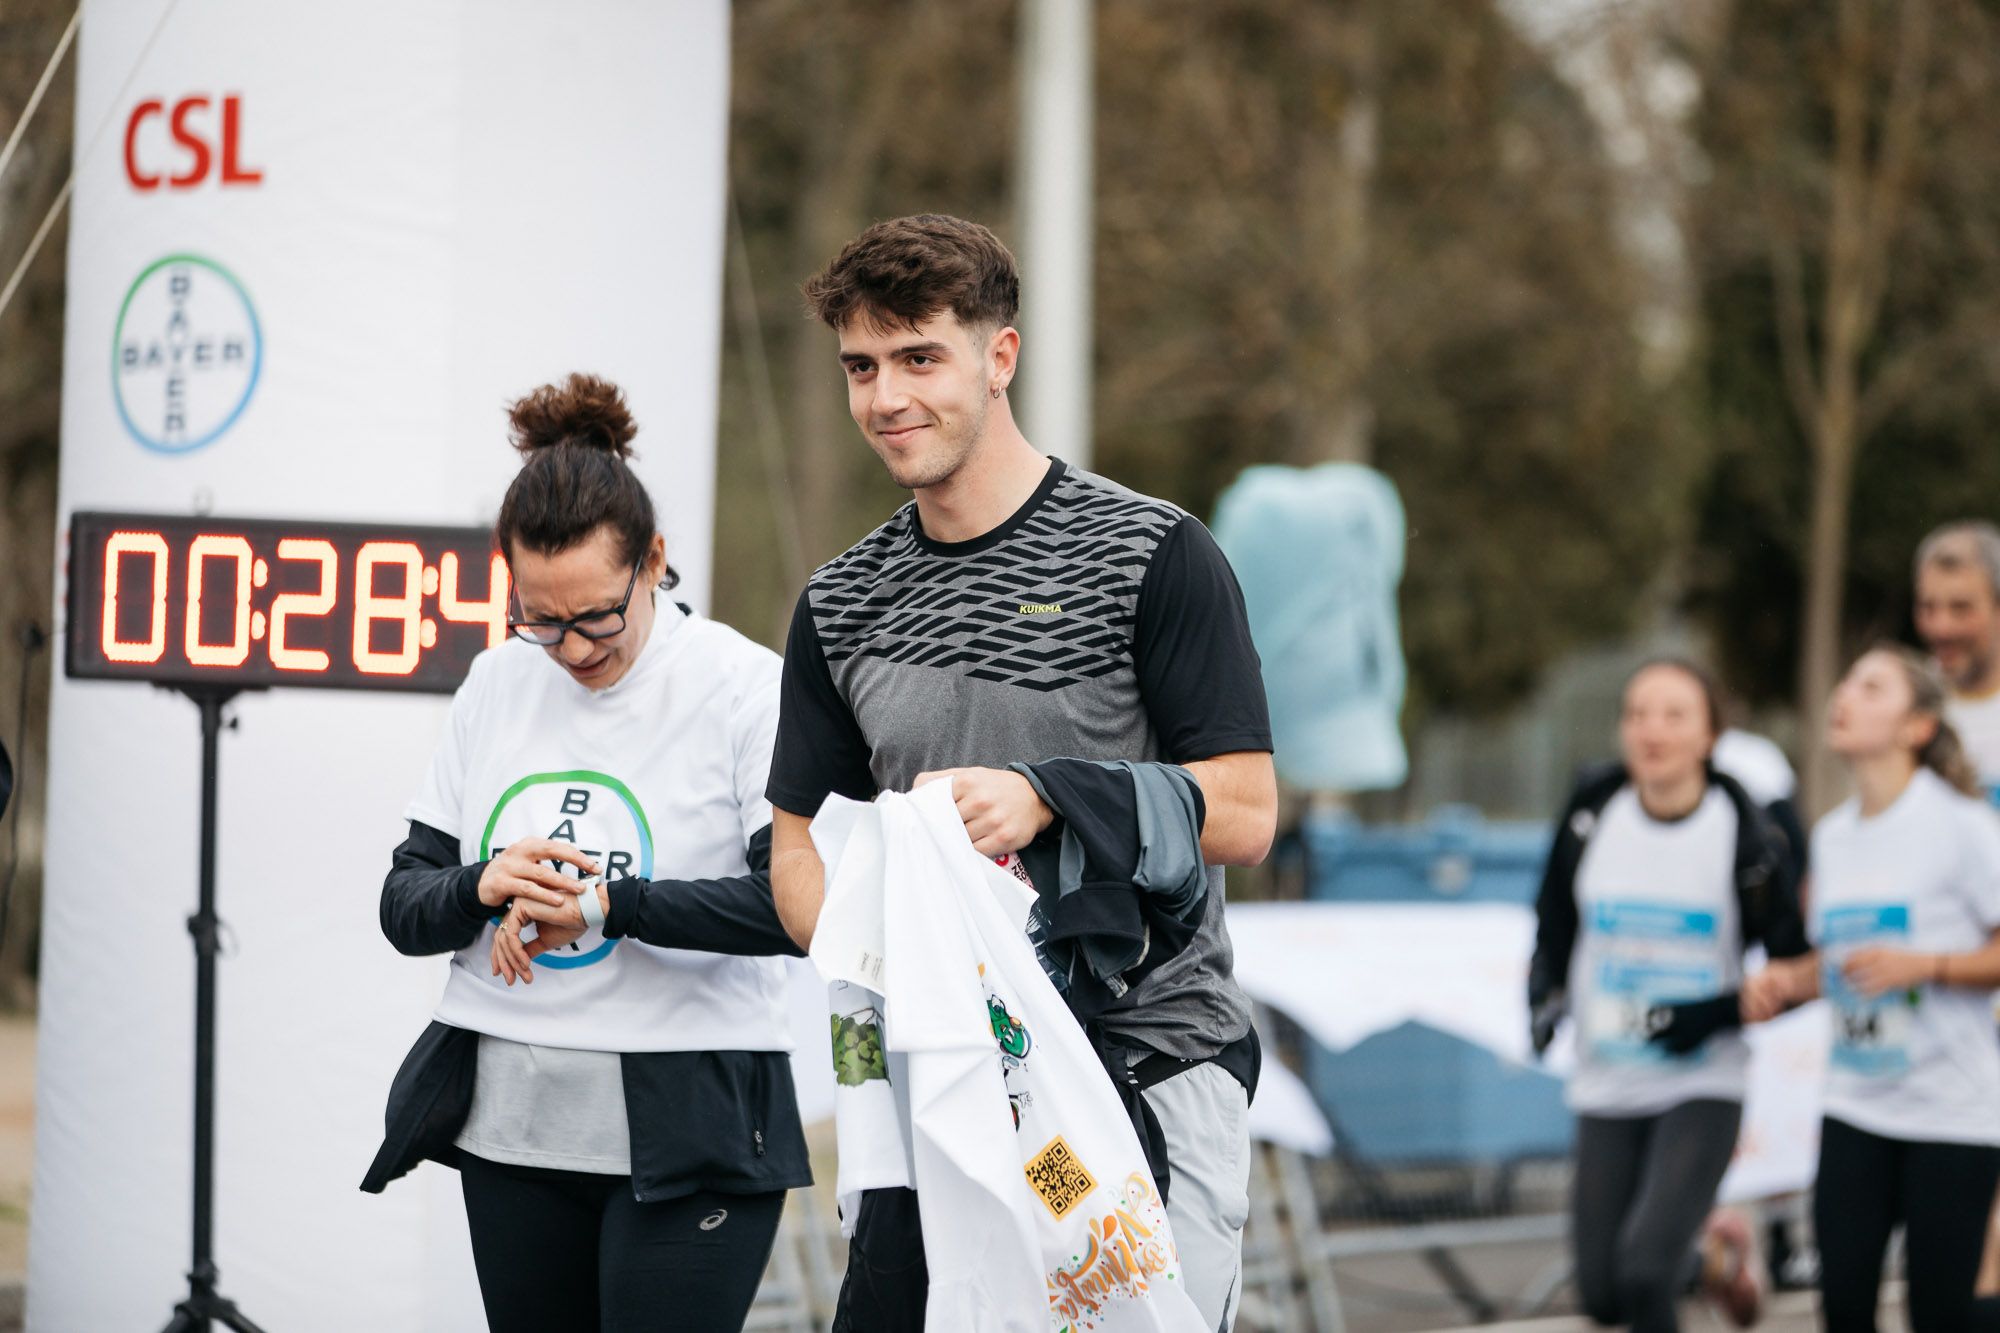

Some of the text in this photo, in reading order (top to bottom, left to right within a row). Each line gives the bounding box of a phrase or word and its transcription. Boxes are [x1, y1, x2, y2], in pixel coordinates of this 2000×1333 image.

[123, 93, 265, 192] CSL
[121, 339, 245, 369] BAYER
[164, 268, 190, 440] BAYER
[102, 529, 512, 675] 00:28:4
[1019, 604, 1062, 614] KUIKMA
